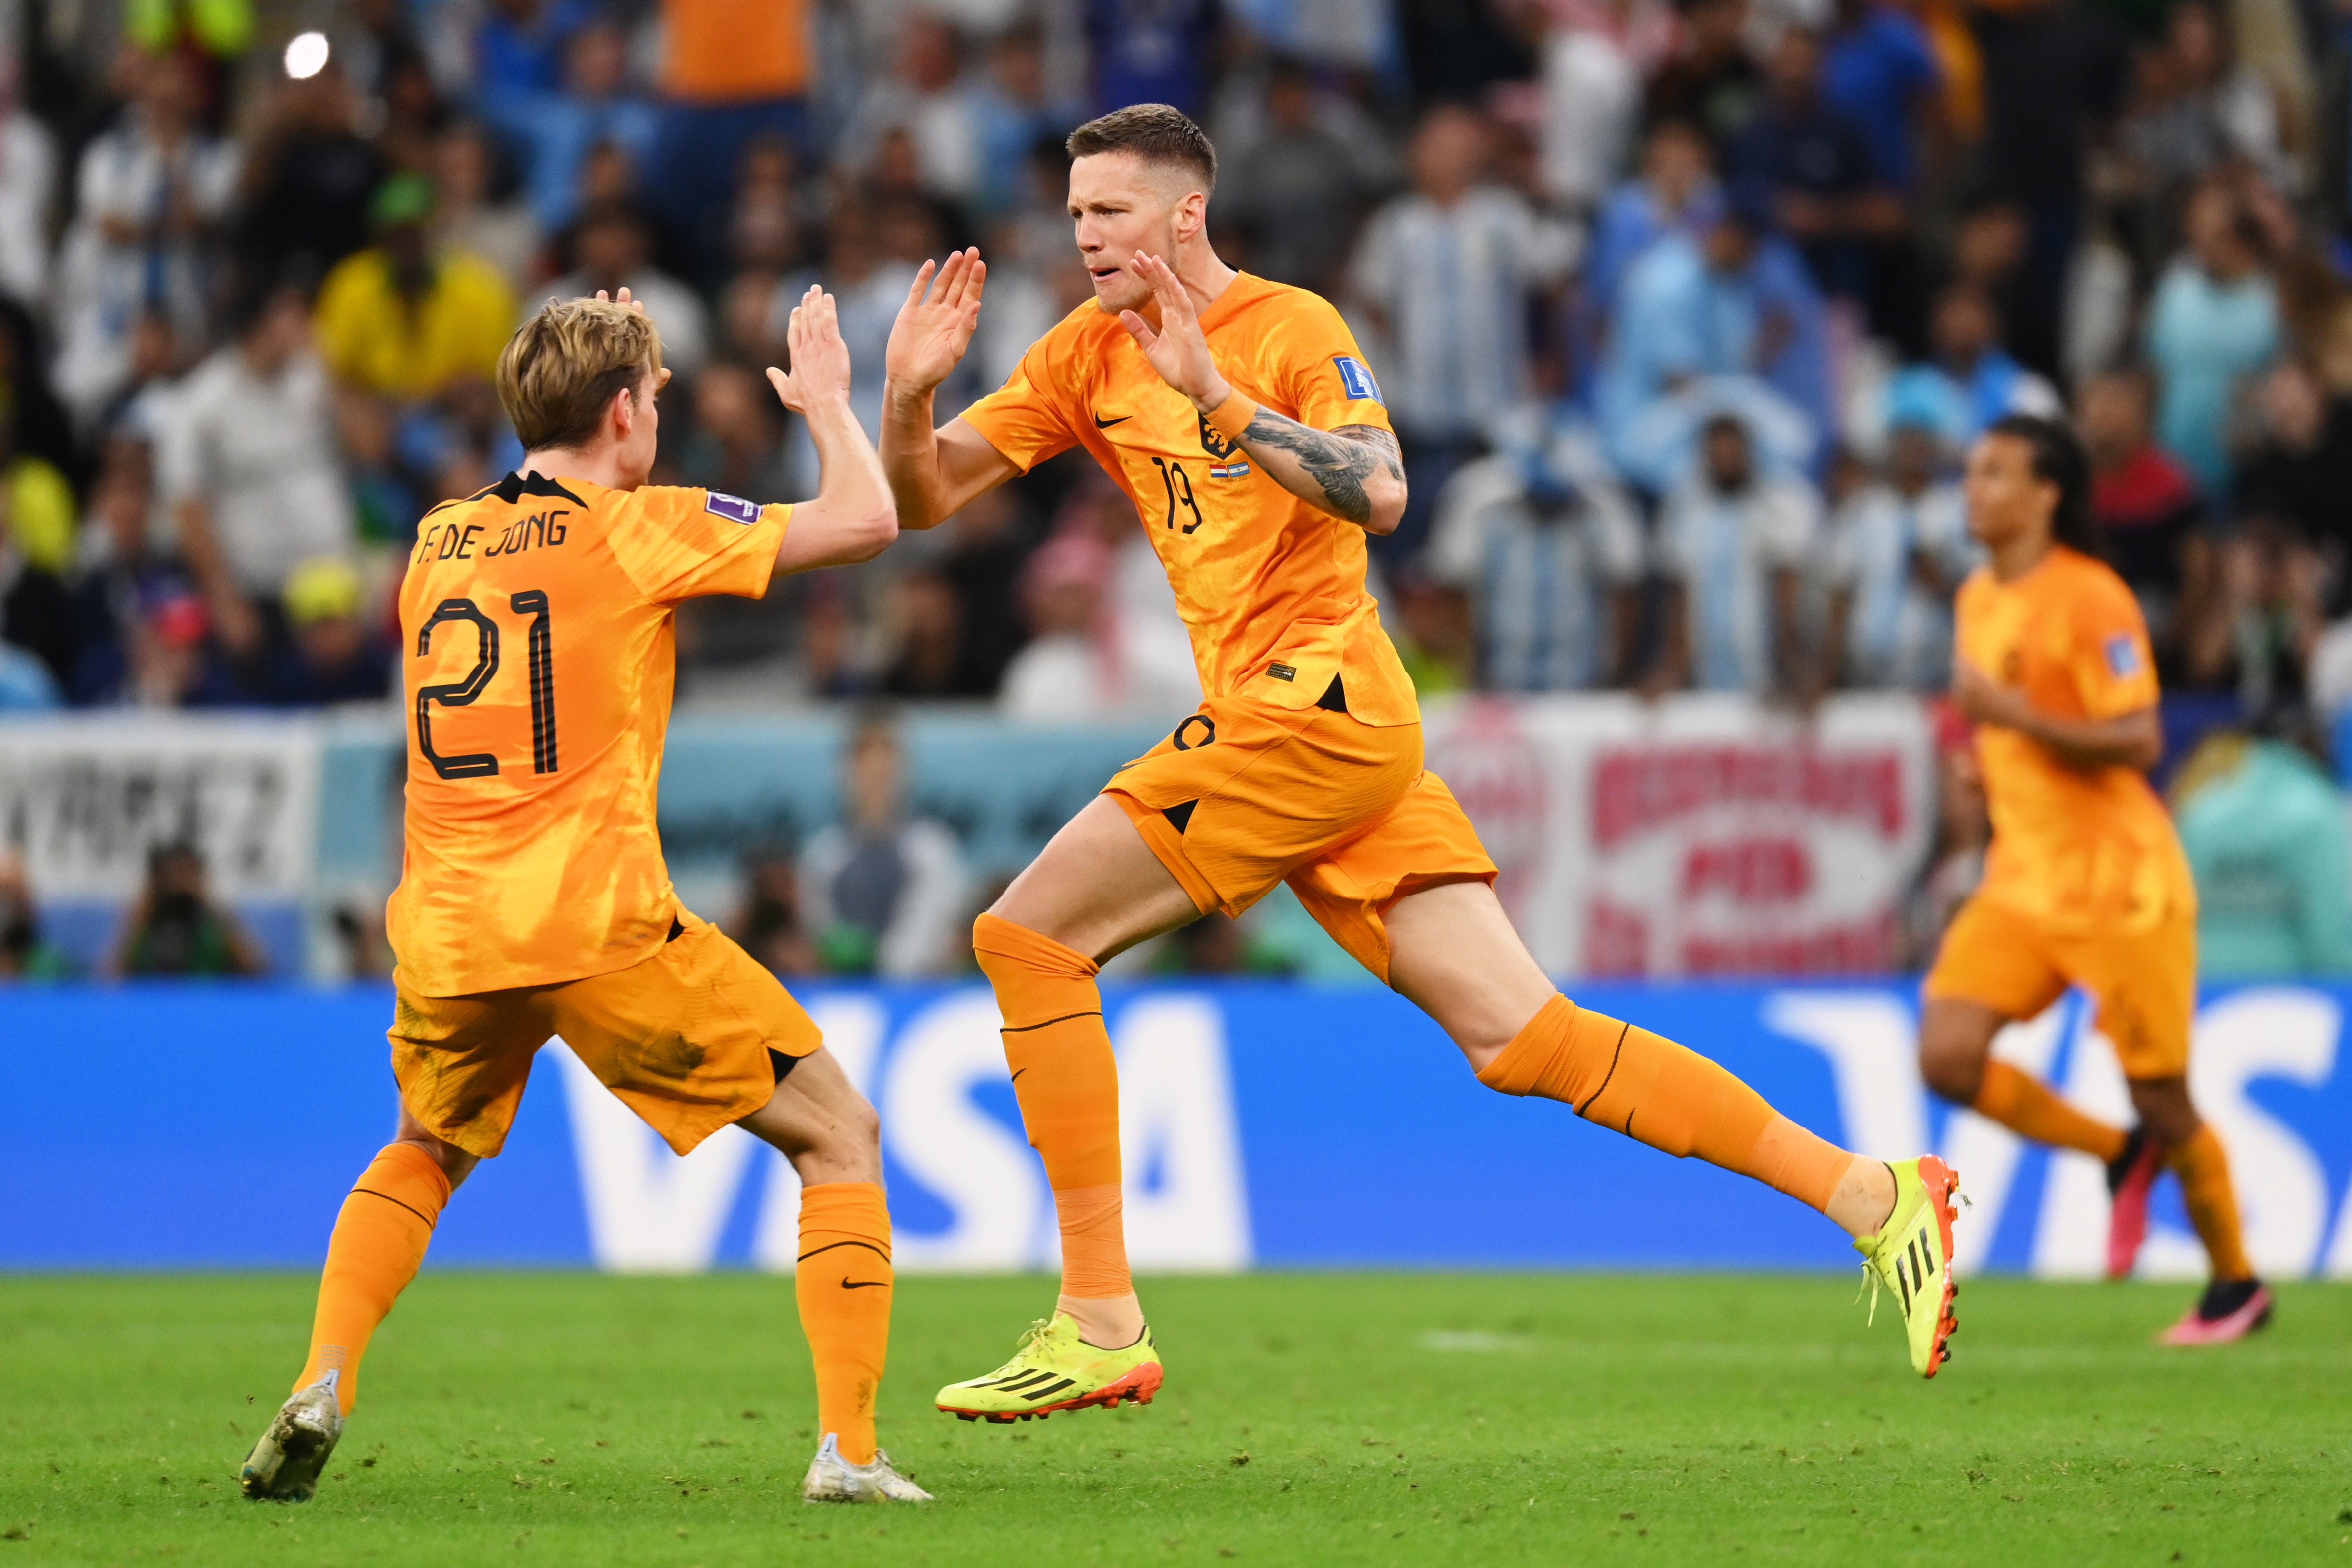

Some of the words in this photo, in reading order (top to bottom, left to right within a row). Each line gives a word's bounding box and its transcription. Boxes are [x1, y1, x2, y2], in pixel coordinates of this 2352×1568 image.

[417, 524, 441, 564] F.
[438, 524, 485, 560] DE
[485, 510, 570, 557] JONG
[1151, 457, 1202, 535] 19
[416, 589, 558, 780] 21
[539, 991, 1252, 1272] VISA
[1763, 988, 2352, 1276] VIS
